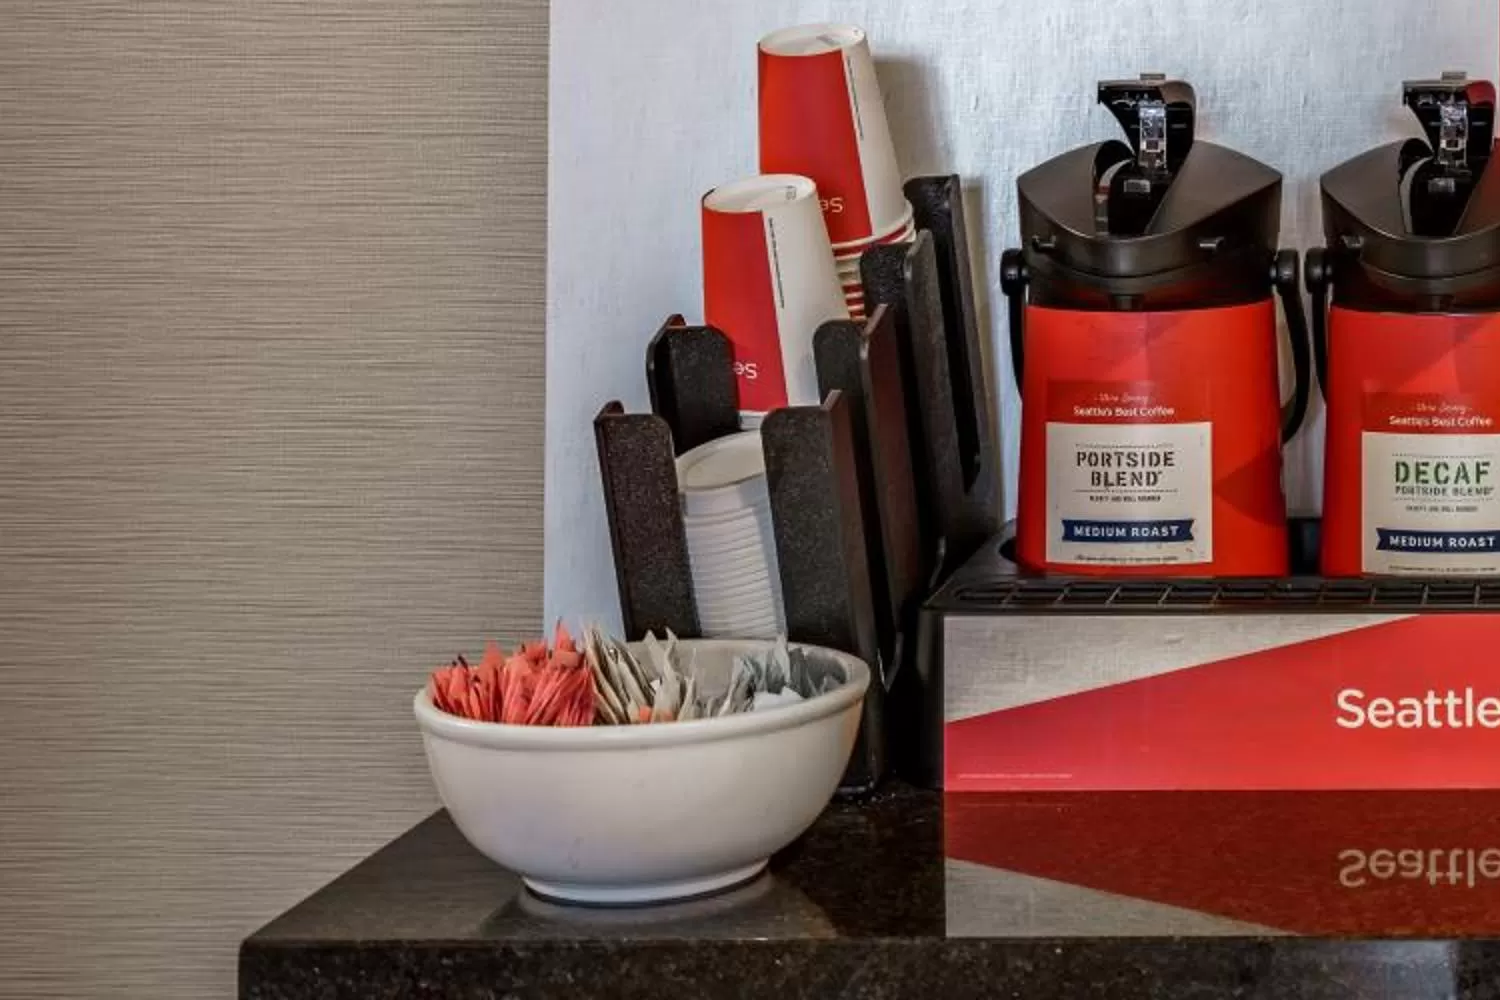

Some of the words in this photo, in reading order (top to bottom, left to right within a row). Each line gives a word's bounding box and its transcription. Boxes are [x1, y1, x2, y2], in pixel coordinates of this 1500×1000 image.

[1076, 451, 1176, 468] PORTSIDE
[1395, 461, 1491, 485] DECAF
[1073, 525, 1126, 537] MEDIUM
[1131, 525, 1179, 537] ROAST
[1389, 535, 1444, 547] MEDIUM
[1449, 536, 1496, 547] ROAST
